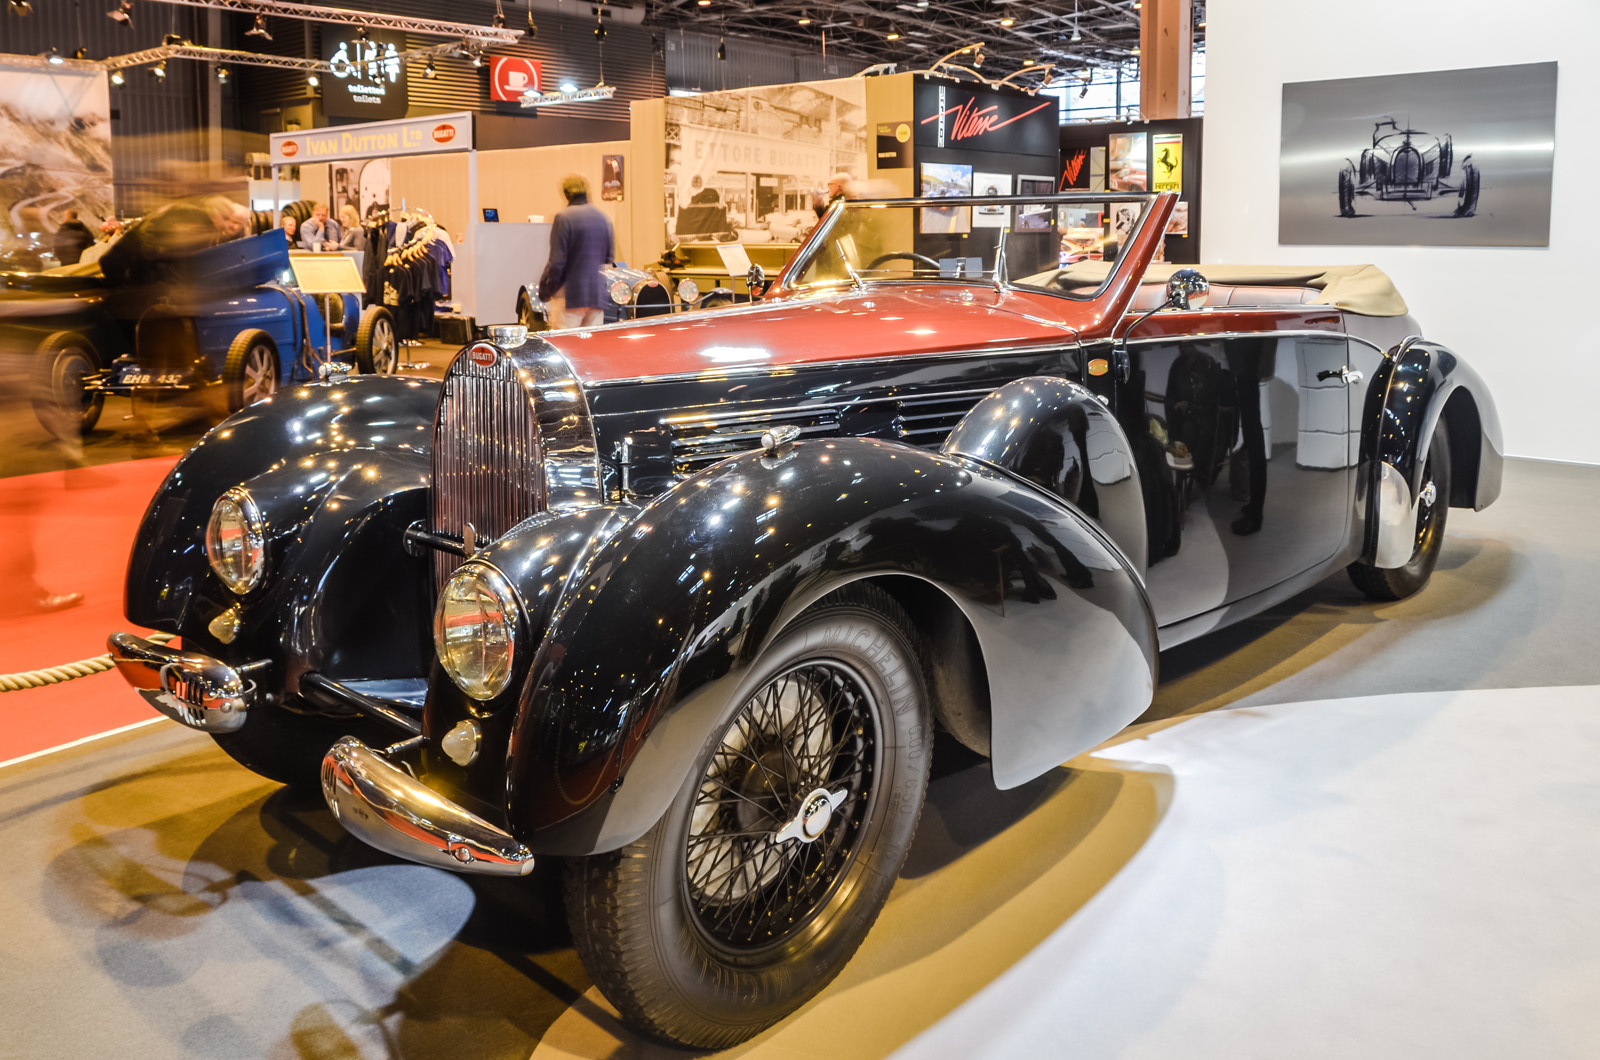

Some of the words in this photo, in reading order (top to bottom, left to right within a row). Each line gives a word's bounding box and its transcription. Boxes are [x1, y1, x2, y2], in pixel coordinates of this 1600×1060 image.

[353, 94, 381, 104] toilets
[433, 128, 454, 139] BUGATTI
[694, 140, 761, 164] ETTORE
[769, 149, 823, 168] BUGATTI
[472, 351, 493, 362] BUGATTI
[122, 374, 151, 384] EHB
[819, 625, 919, 717] MICHELIN
